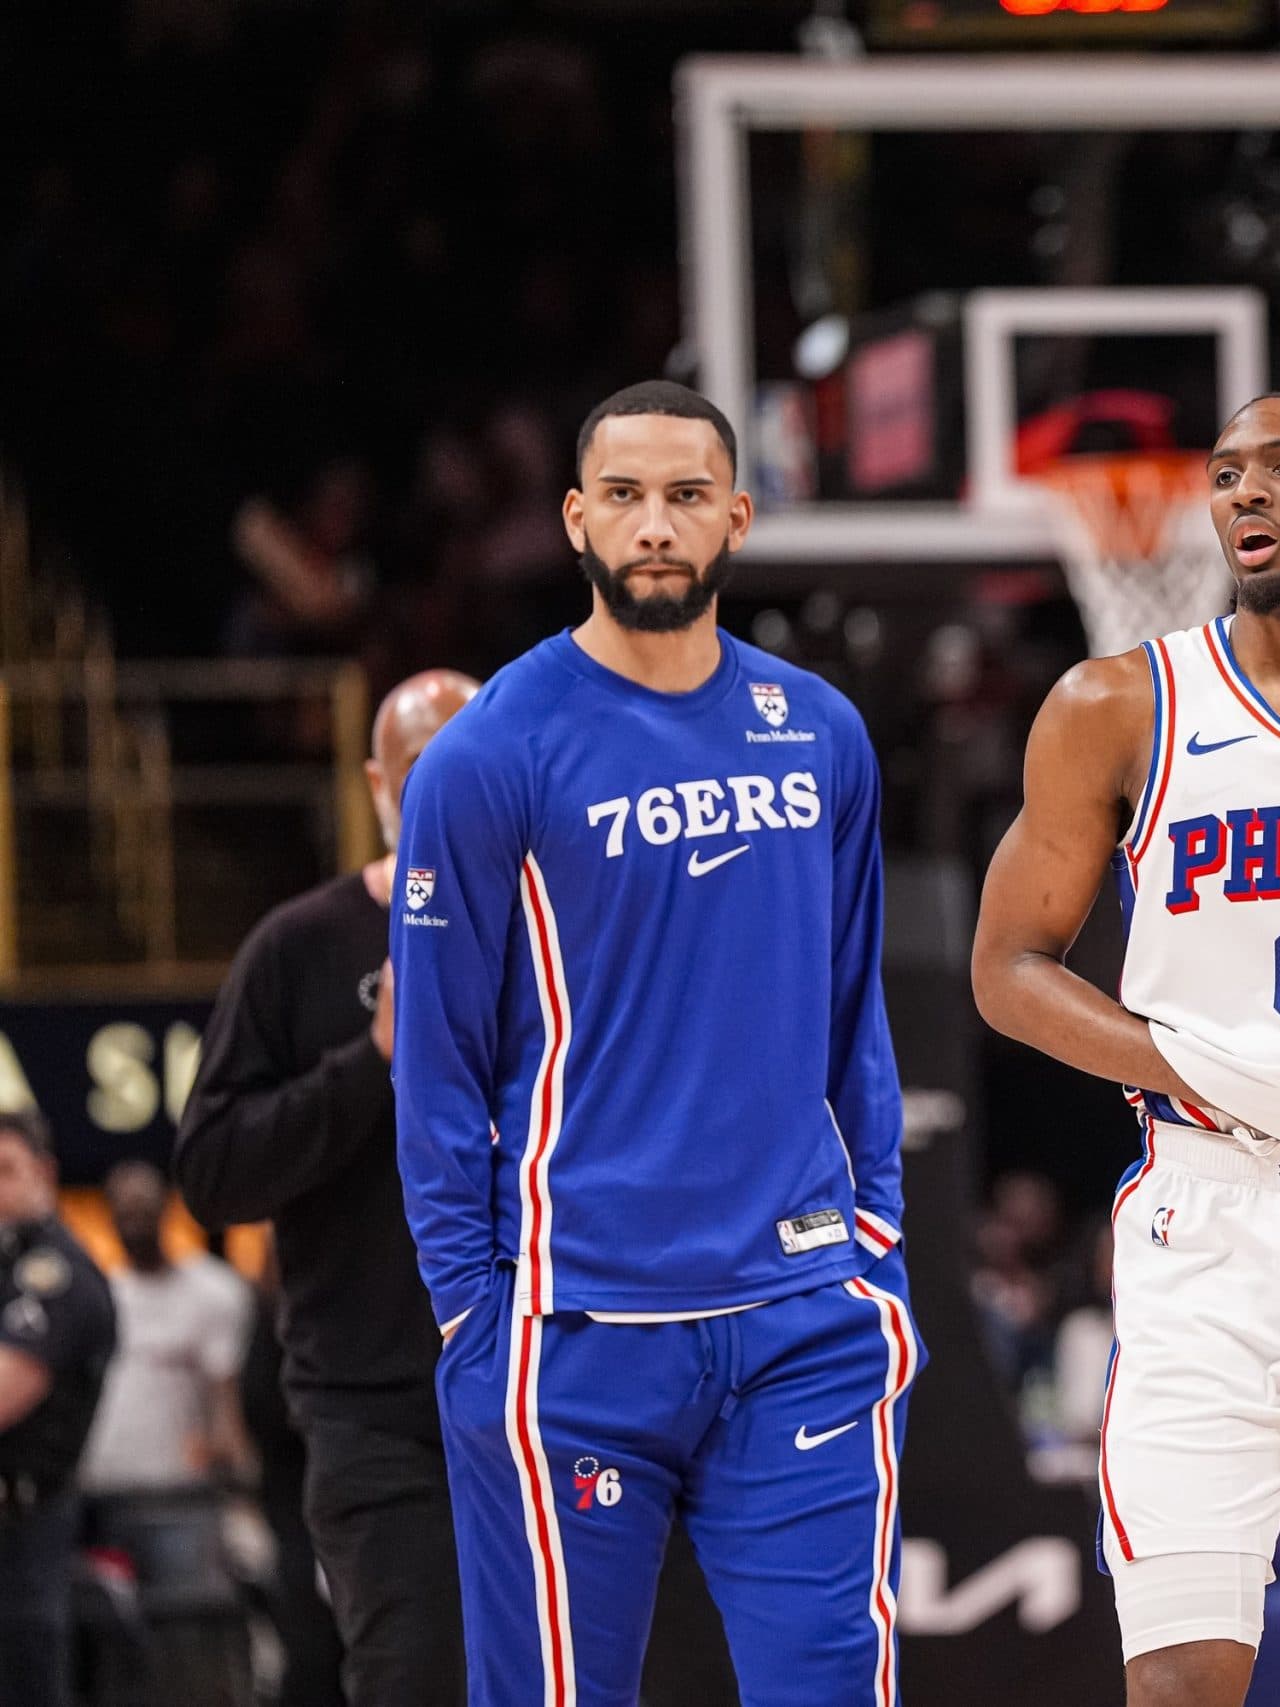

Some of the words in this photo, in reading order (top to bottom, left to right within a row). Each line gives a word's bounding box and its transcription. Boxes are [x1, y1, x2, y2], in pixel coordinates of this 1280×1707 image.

[586, 771, 822, 859] 76ERS
[406, 913, 449, 928] Medicine
[573, 1467, 623, 1511] 76
